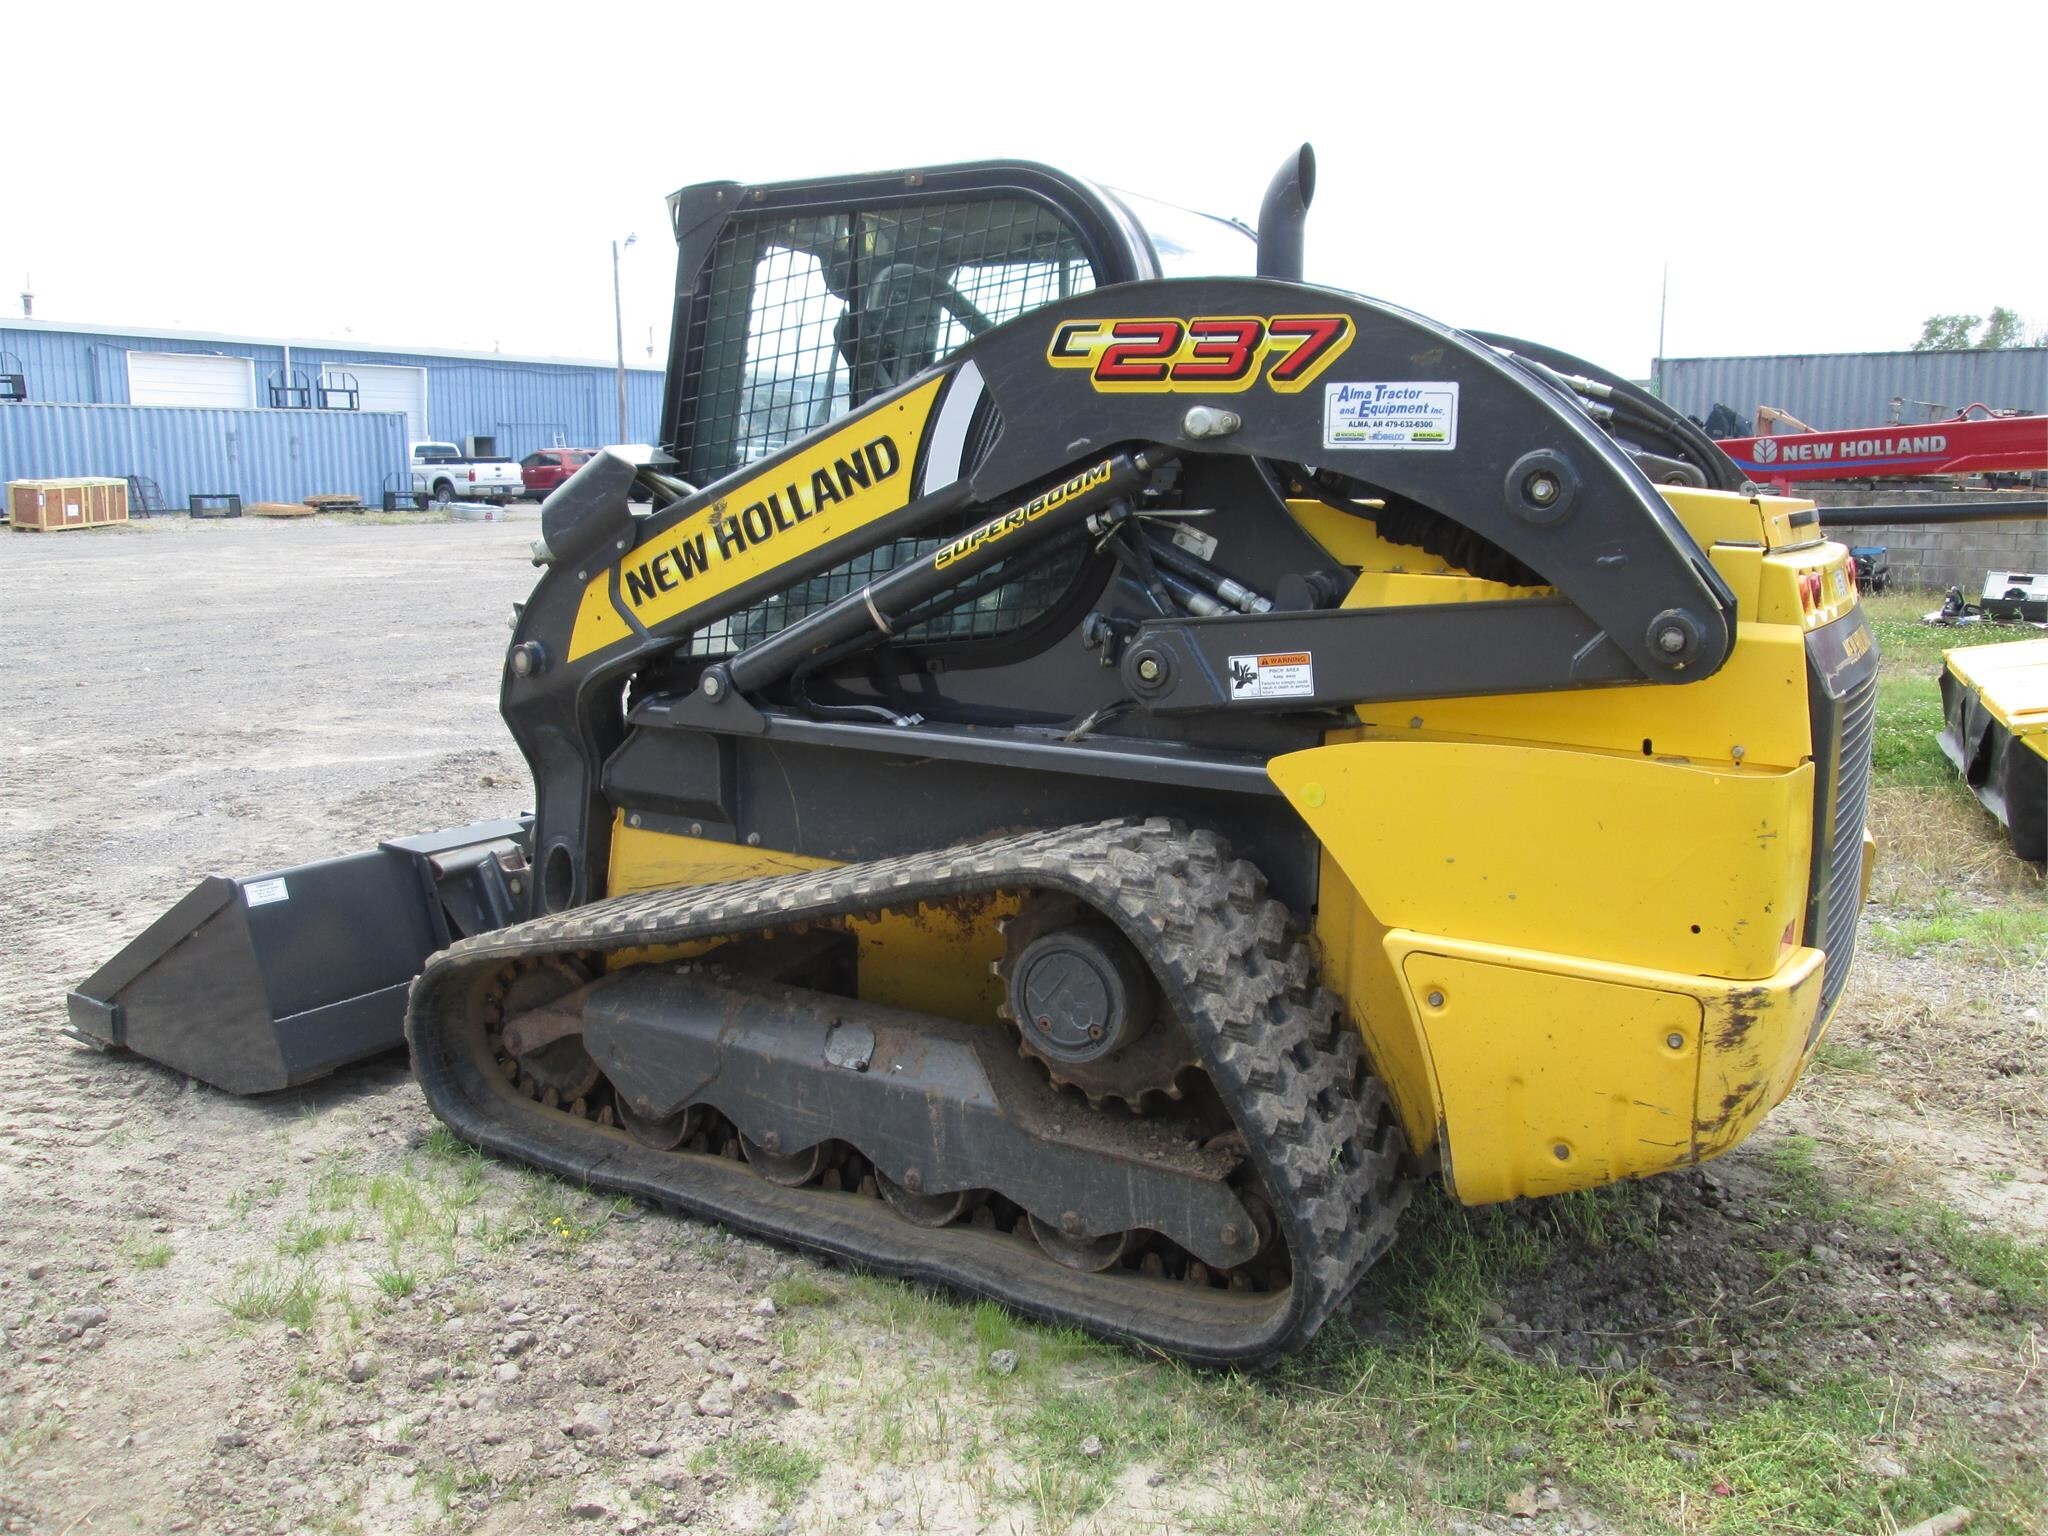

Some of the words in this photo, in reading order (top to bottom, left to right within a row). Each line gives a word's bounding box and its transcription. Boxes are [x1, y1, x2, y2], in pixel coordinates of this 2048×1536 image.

[1048, 314, 1355, 391] C237
[1337, 384, 1372, 402] Alma
[1374, 384, 1422, 402] Tractor
[1339, 407, 1355, 415] and
[1358, 400, 1429, 418] Equipment
[1348, 420, 1371, 429] ALMA,
[1373, 420, 1383, 428] AR
[1782, 443, 1834, 462] NEW
[1840, 435, 1947, 459] HOLLAND
[625, 532, 710, 607] NEW
[713, 434, 900, 561] HOLLAND
[935, 507, 1024, 570] SUPER
[1026, 459, 1112, 522] BOOM
[1270, 656, 1306, 664] WARNING
